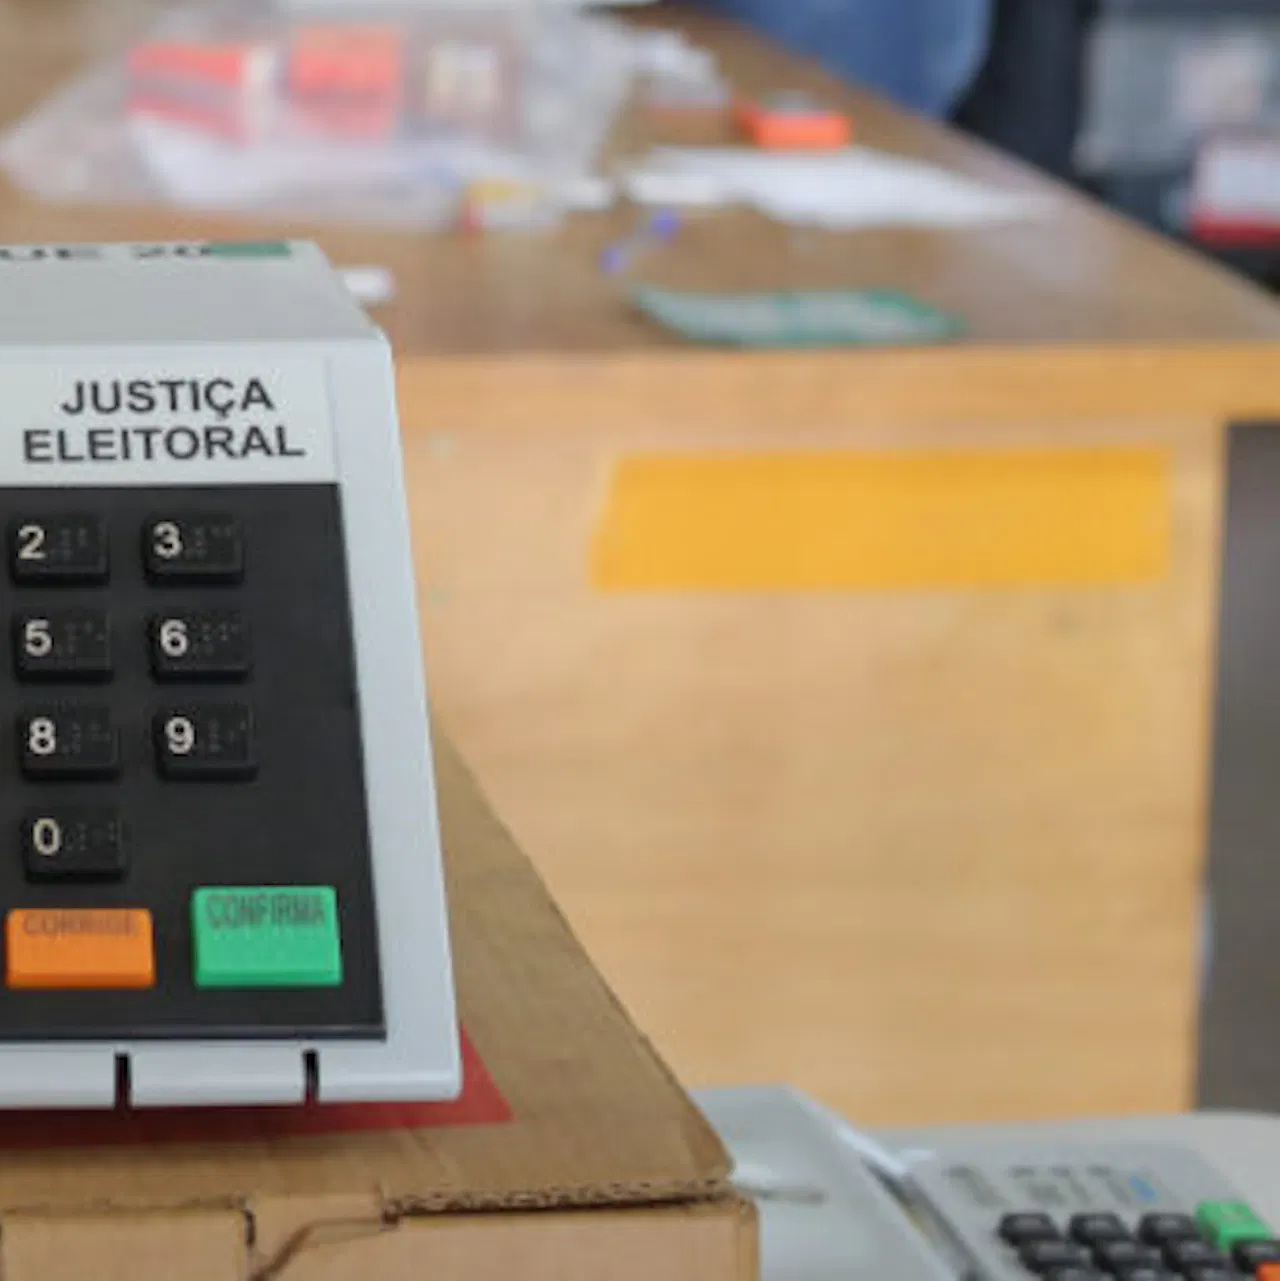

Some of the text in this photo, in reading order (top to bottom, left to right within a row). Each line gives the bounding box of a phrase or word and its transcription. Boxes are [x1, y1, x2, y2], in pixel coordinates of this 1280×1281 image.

[61, 377, 275, 420] JUSTIÇA
[22, 424, 308, 463] ELEITORAL
[17, 525, 47, 560] 2
[153, 522, 183, 559] 3
[24, 619, 53, 656] 5
[159, 619, 189, 657] 6
[29, 717, 56, 755] 8
[165, 716, 195, 755] 9
[32, 818, 61, 856] 0
[205, 892, 326, 929] CONFIRMA
